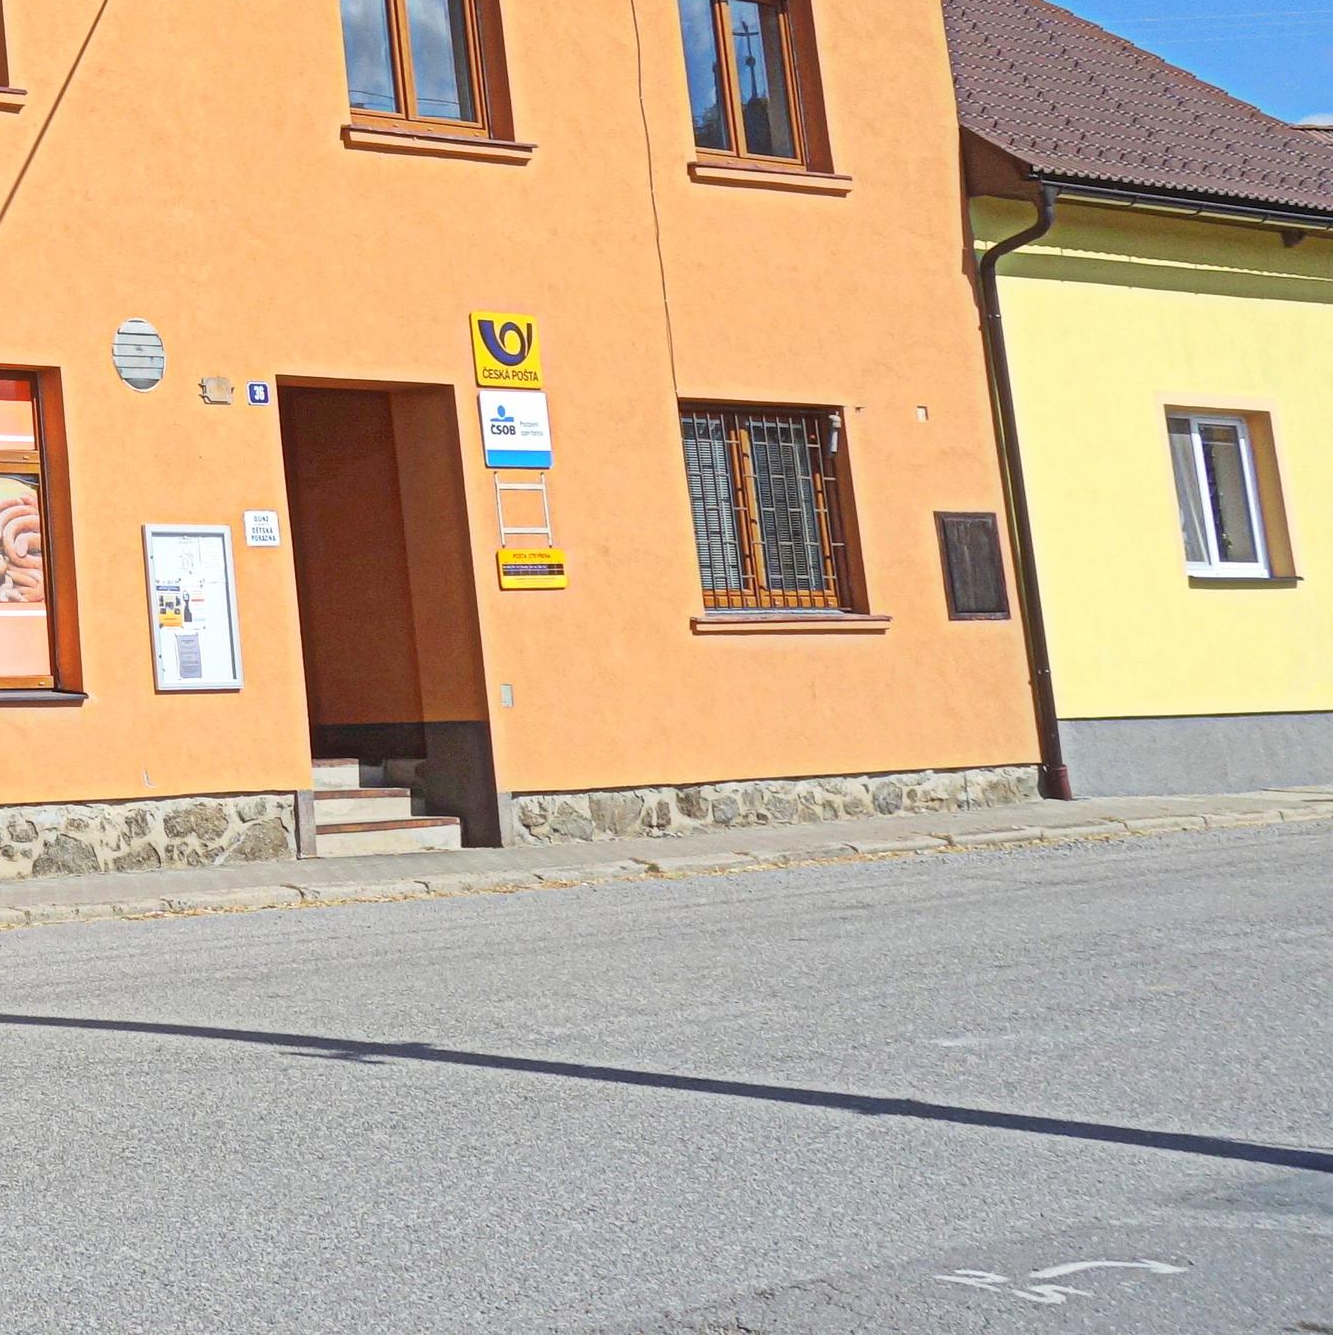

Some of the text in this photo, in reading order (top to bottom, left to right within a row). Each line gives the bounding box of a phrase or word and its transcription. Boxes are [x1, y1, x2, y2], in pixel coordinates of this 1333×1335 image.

[482, 367, 539, 382] ČESKÁ POŠTA
[254, 385, 265, 401] 36
[490, 424, 516, 435] ČSOB
